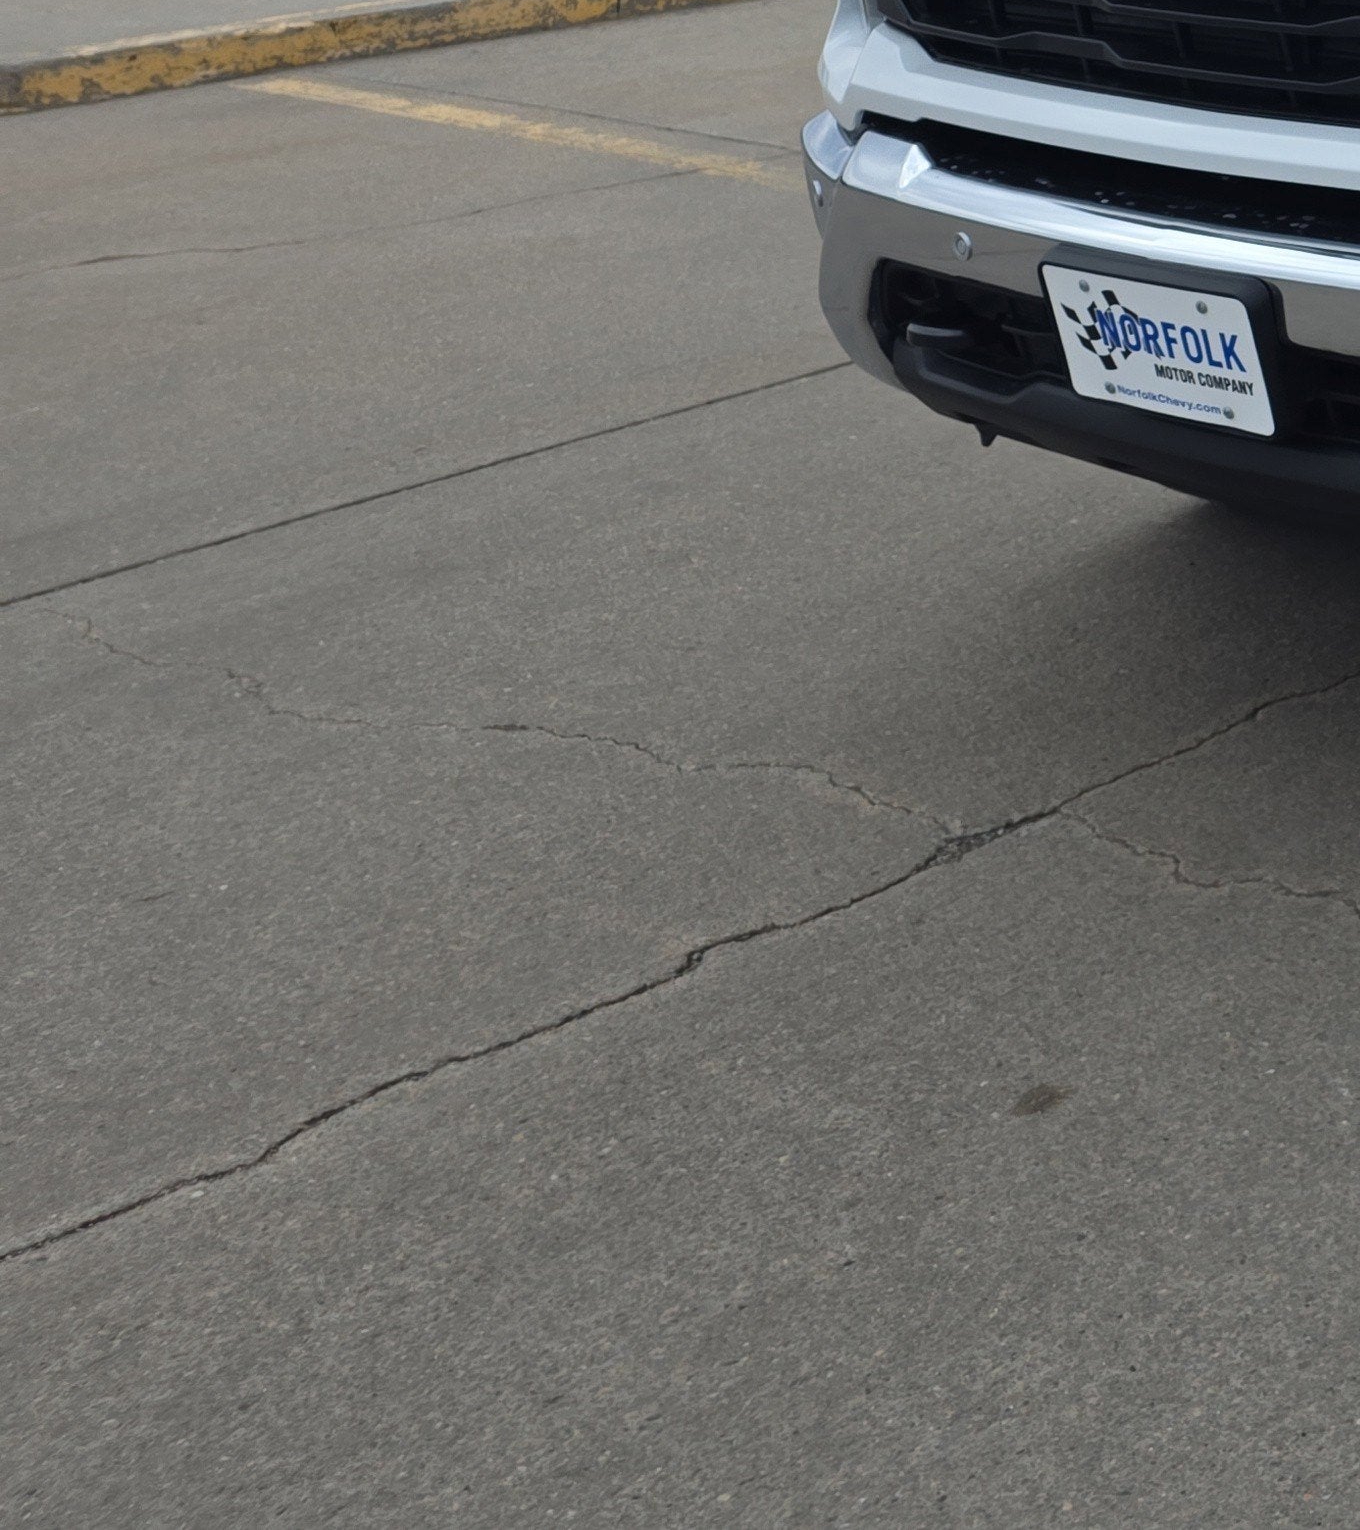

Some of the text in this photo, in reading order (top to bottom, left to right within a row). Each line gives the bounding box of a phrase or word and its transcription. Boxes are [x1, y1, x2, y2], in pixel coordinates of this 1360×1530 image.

[1095, 309, 1247, 373] NORFOLK
[1153, 363, 1255, 397] MOTOR COMPANY
[1116, 384, 1222, 415] NorfolkChevy.com
